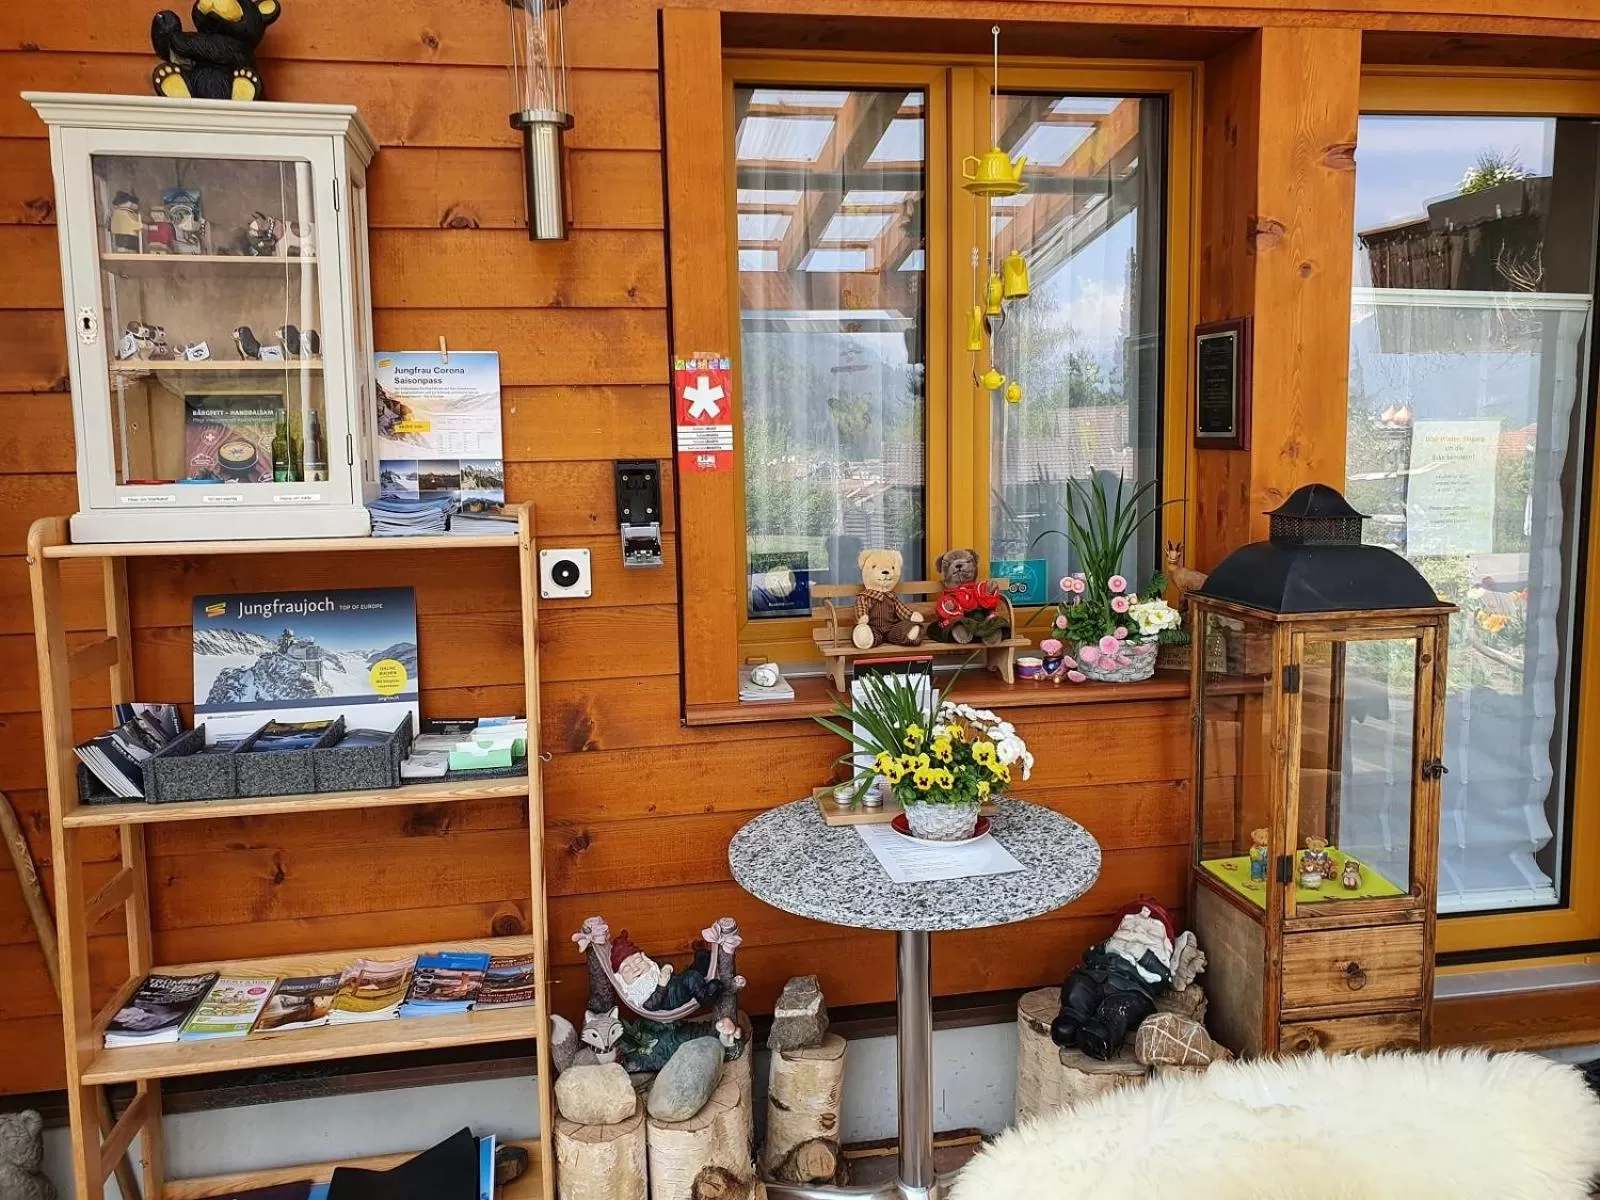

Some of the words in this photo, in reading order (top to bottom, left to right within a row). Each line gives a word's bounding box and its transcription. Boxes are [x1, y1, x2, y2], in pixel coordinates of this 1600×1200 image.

[394, 366, 431, 375] Jungfrau
[433, 366, 465, 374] Corona
[394, 376, 443, 385] Saisonpass
[238, 596, 335, 619] Jungfraujoch
[360, 602, 384, 610] EUROPE
